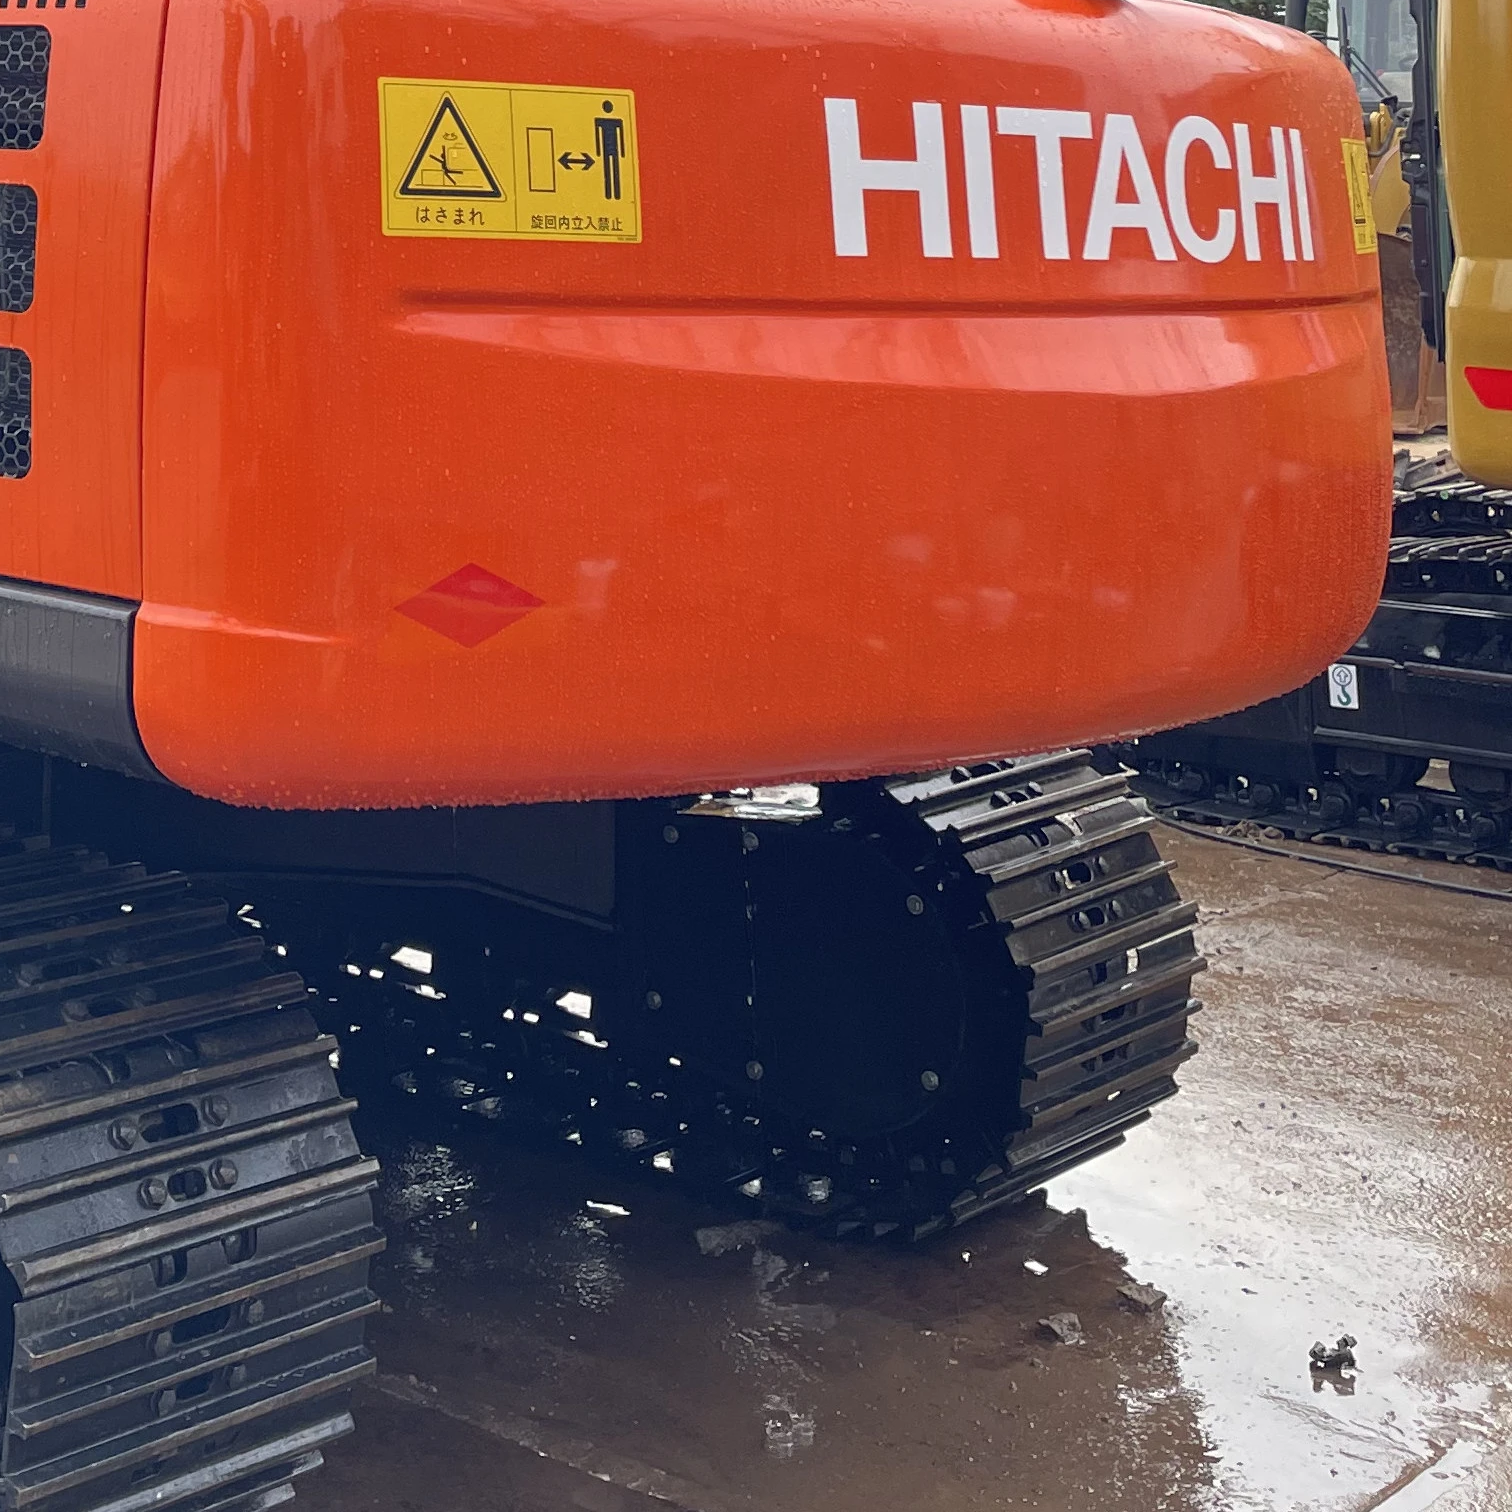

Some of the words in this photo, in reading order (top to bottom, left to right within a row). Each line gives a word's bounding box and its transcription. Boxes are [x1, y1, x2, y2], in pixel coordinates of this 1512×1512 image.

[823, 97, 1315, 265] HITACHI
[415, 205, 486, 227] はさまれ
[531, 214, 624, 232] 旋回内立入禁止
